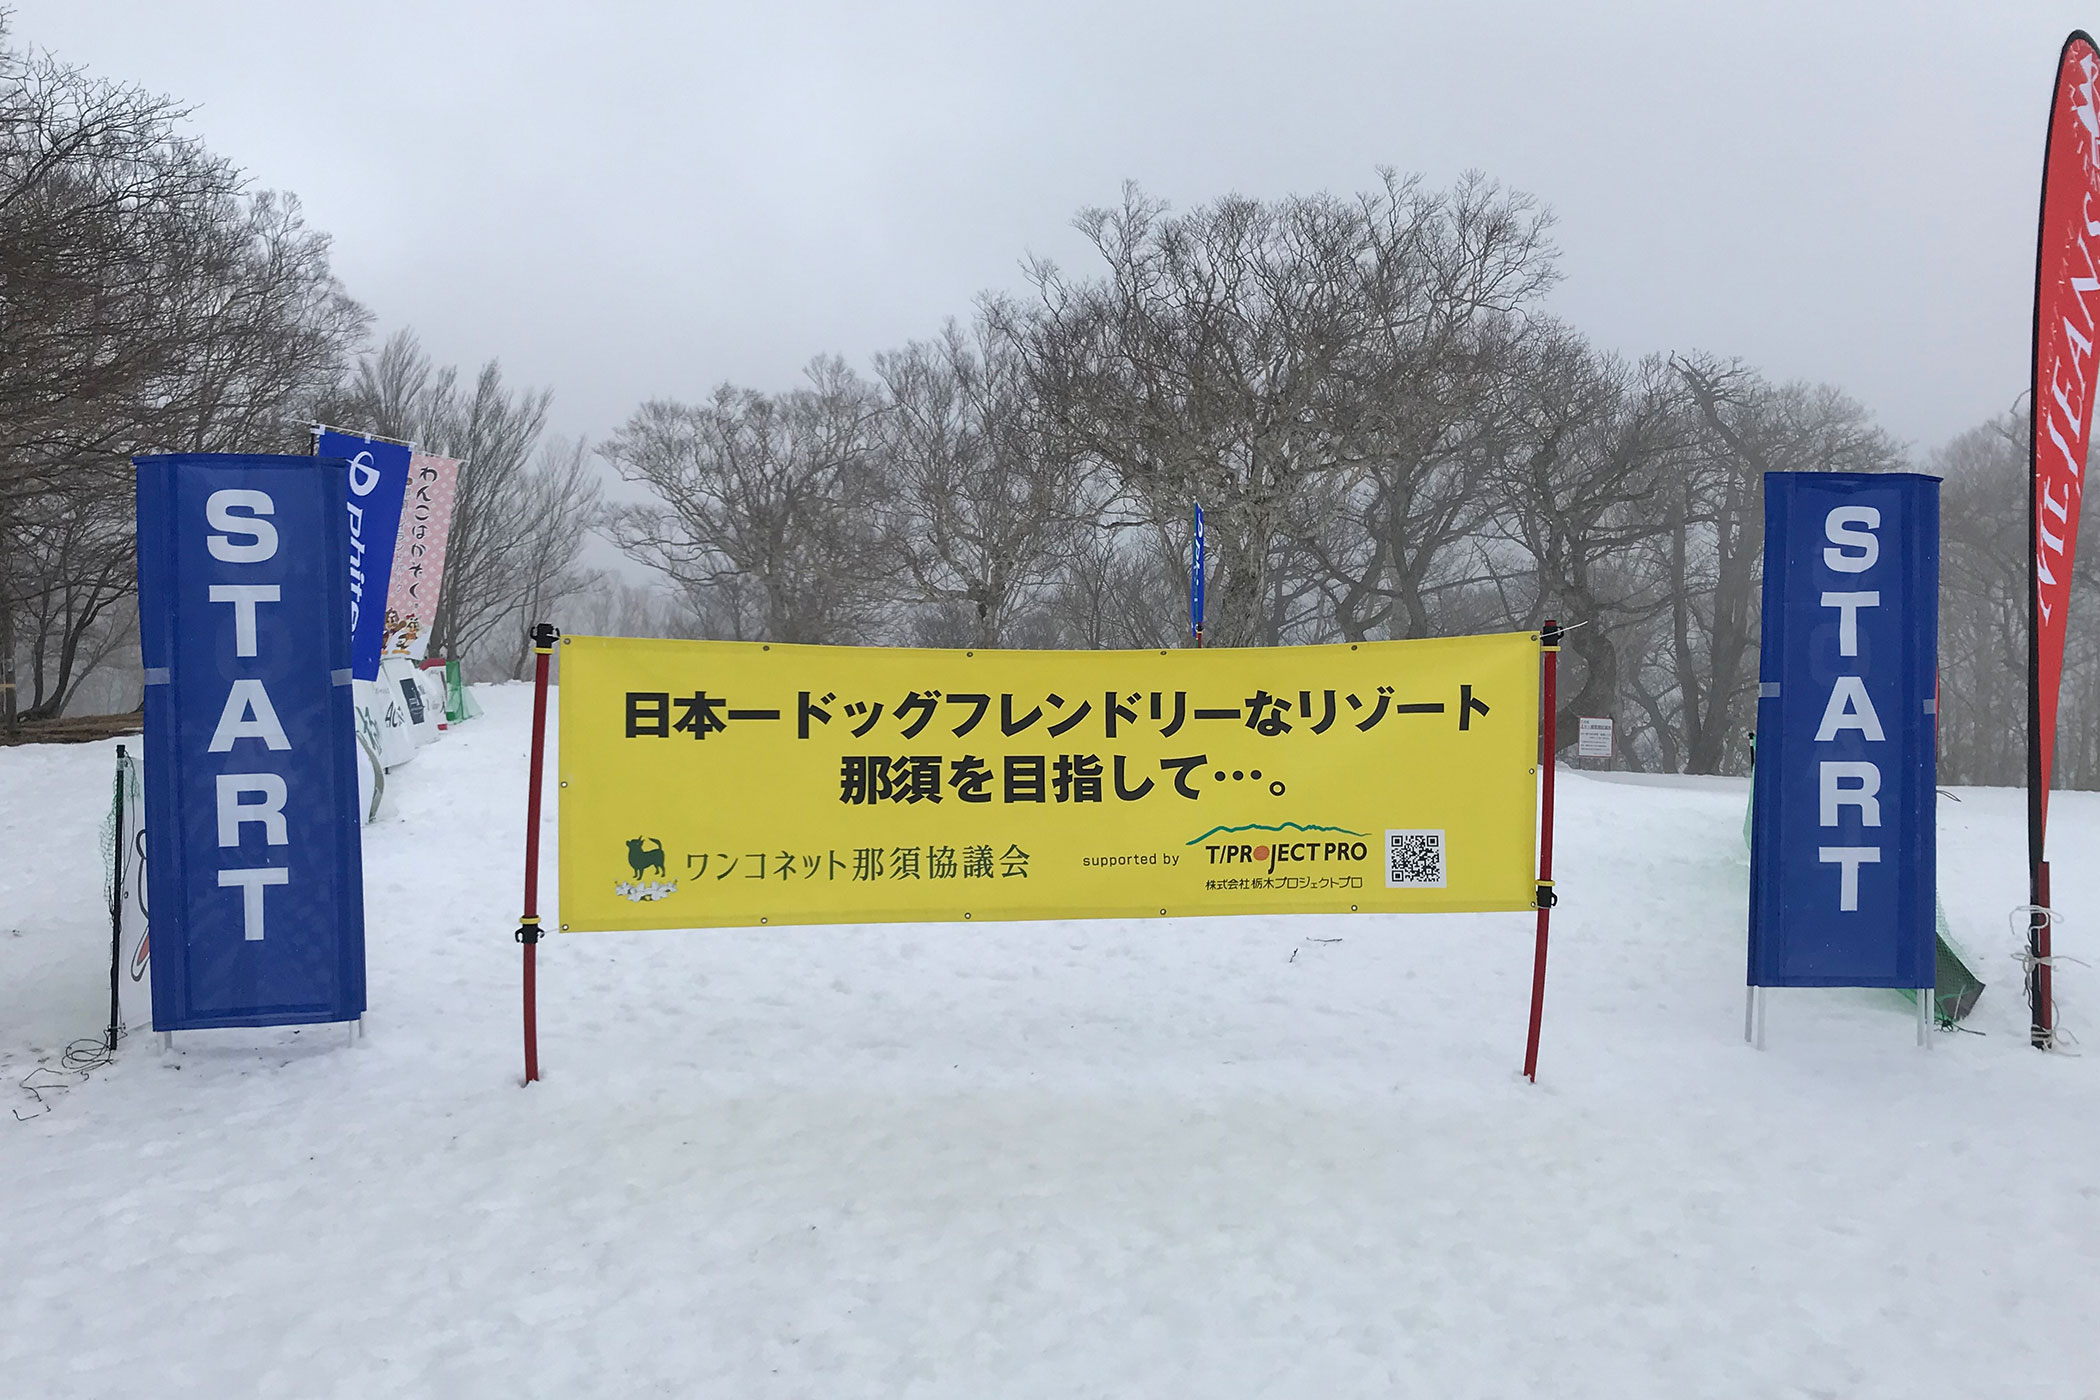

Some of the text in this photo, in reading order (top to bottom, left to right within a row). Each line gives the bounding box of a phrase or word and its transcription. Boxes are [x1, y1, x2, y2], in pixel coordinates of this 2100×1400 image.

[206, 488, 291, 941] START
[625, 684, 1491, 740] 日本一ドッグフレンドリーなリゾート
[1815, 506, 1885, 912] START
[686, 843, 1031, 882] ワンコネット那須協議会
[1083, 853, 1180, 868] supported by
[1324, 842, 1368, 861] PRO
